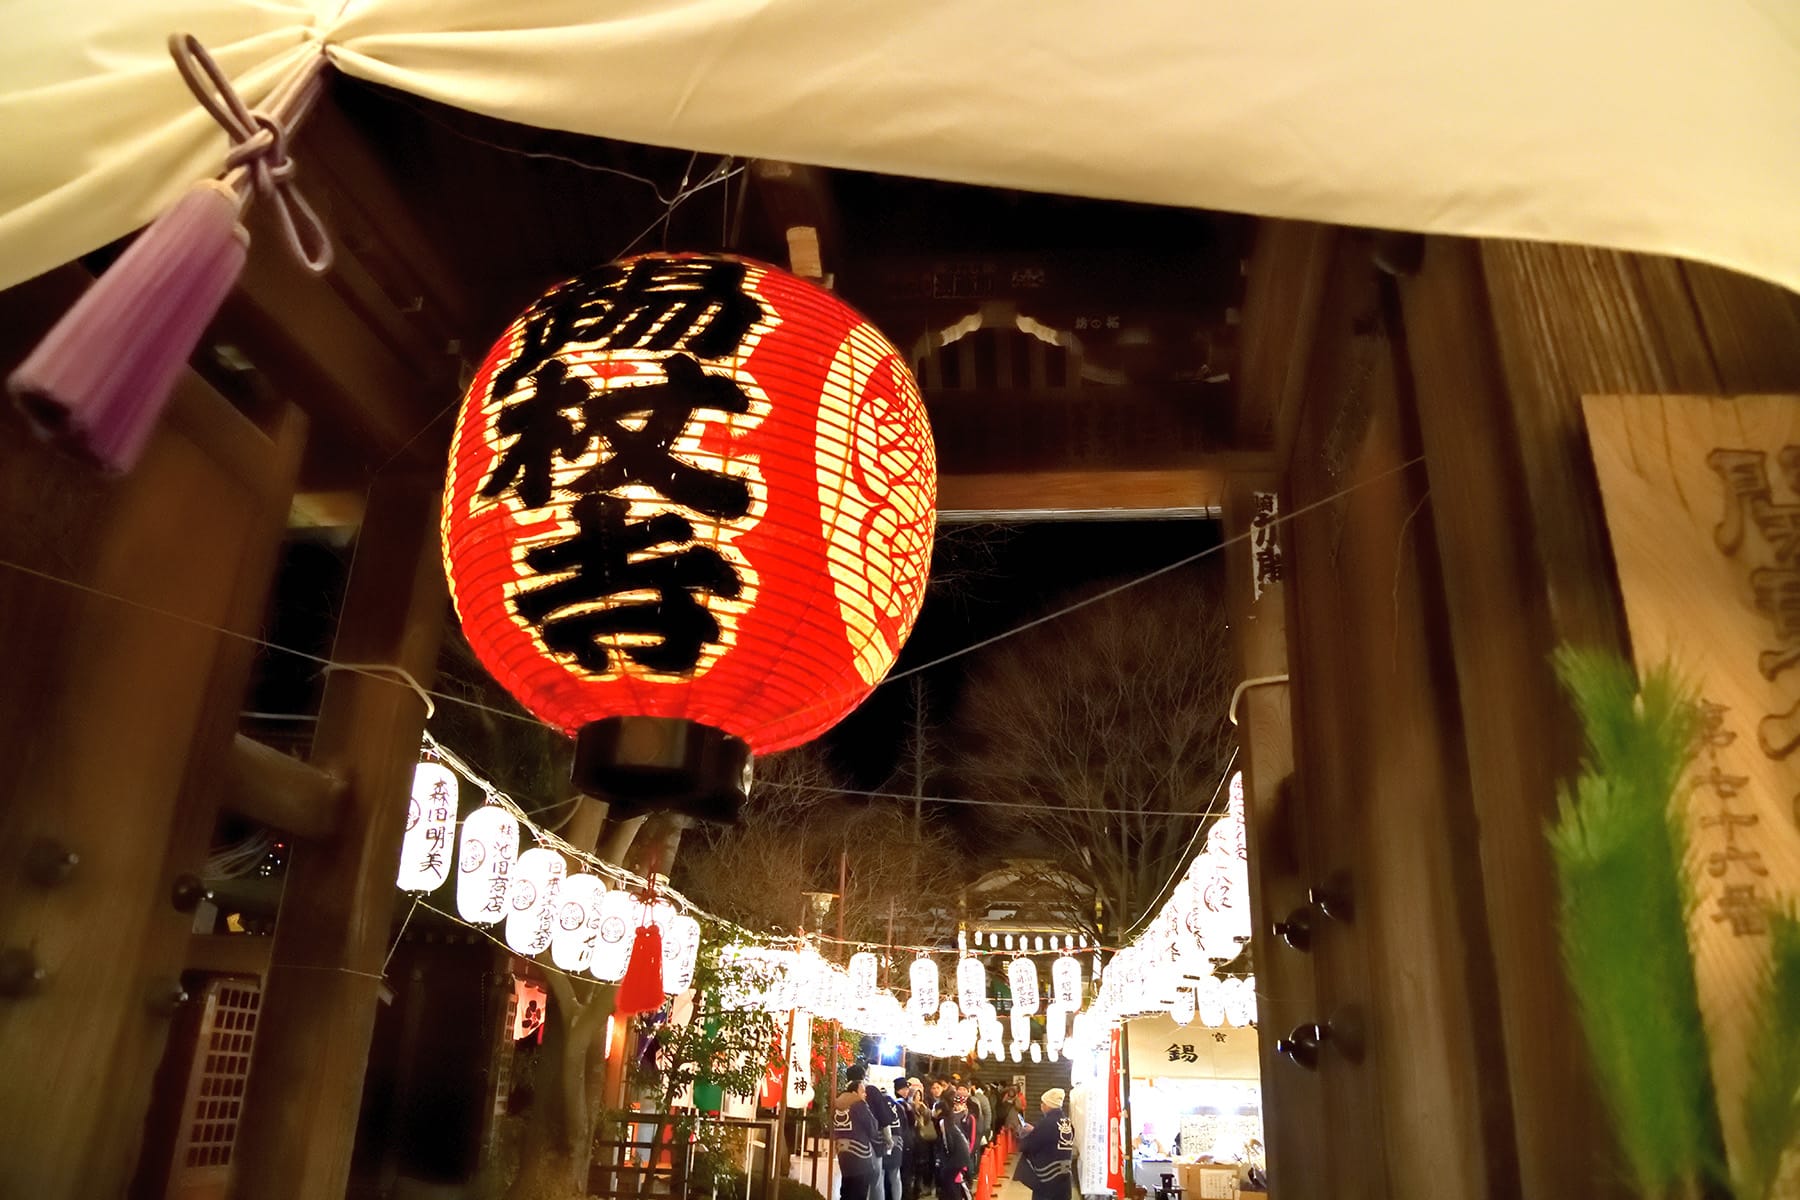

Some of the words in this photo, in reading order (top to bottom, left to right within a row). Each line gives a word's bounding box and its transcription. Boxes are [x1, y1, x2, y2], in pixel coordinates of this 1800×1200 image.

[419, 777, 447, 879] 森田明美
[1164, 1042, 1200, 1064] 錫
